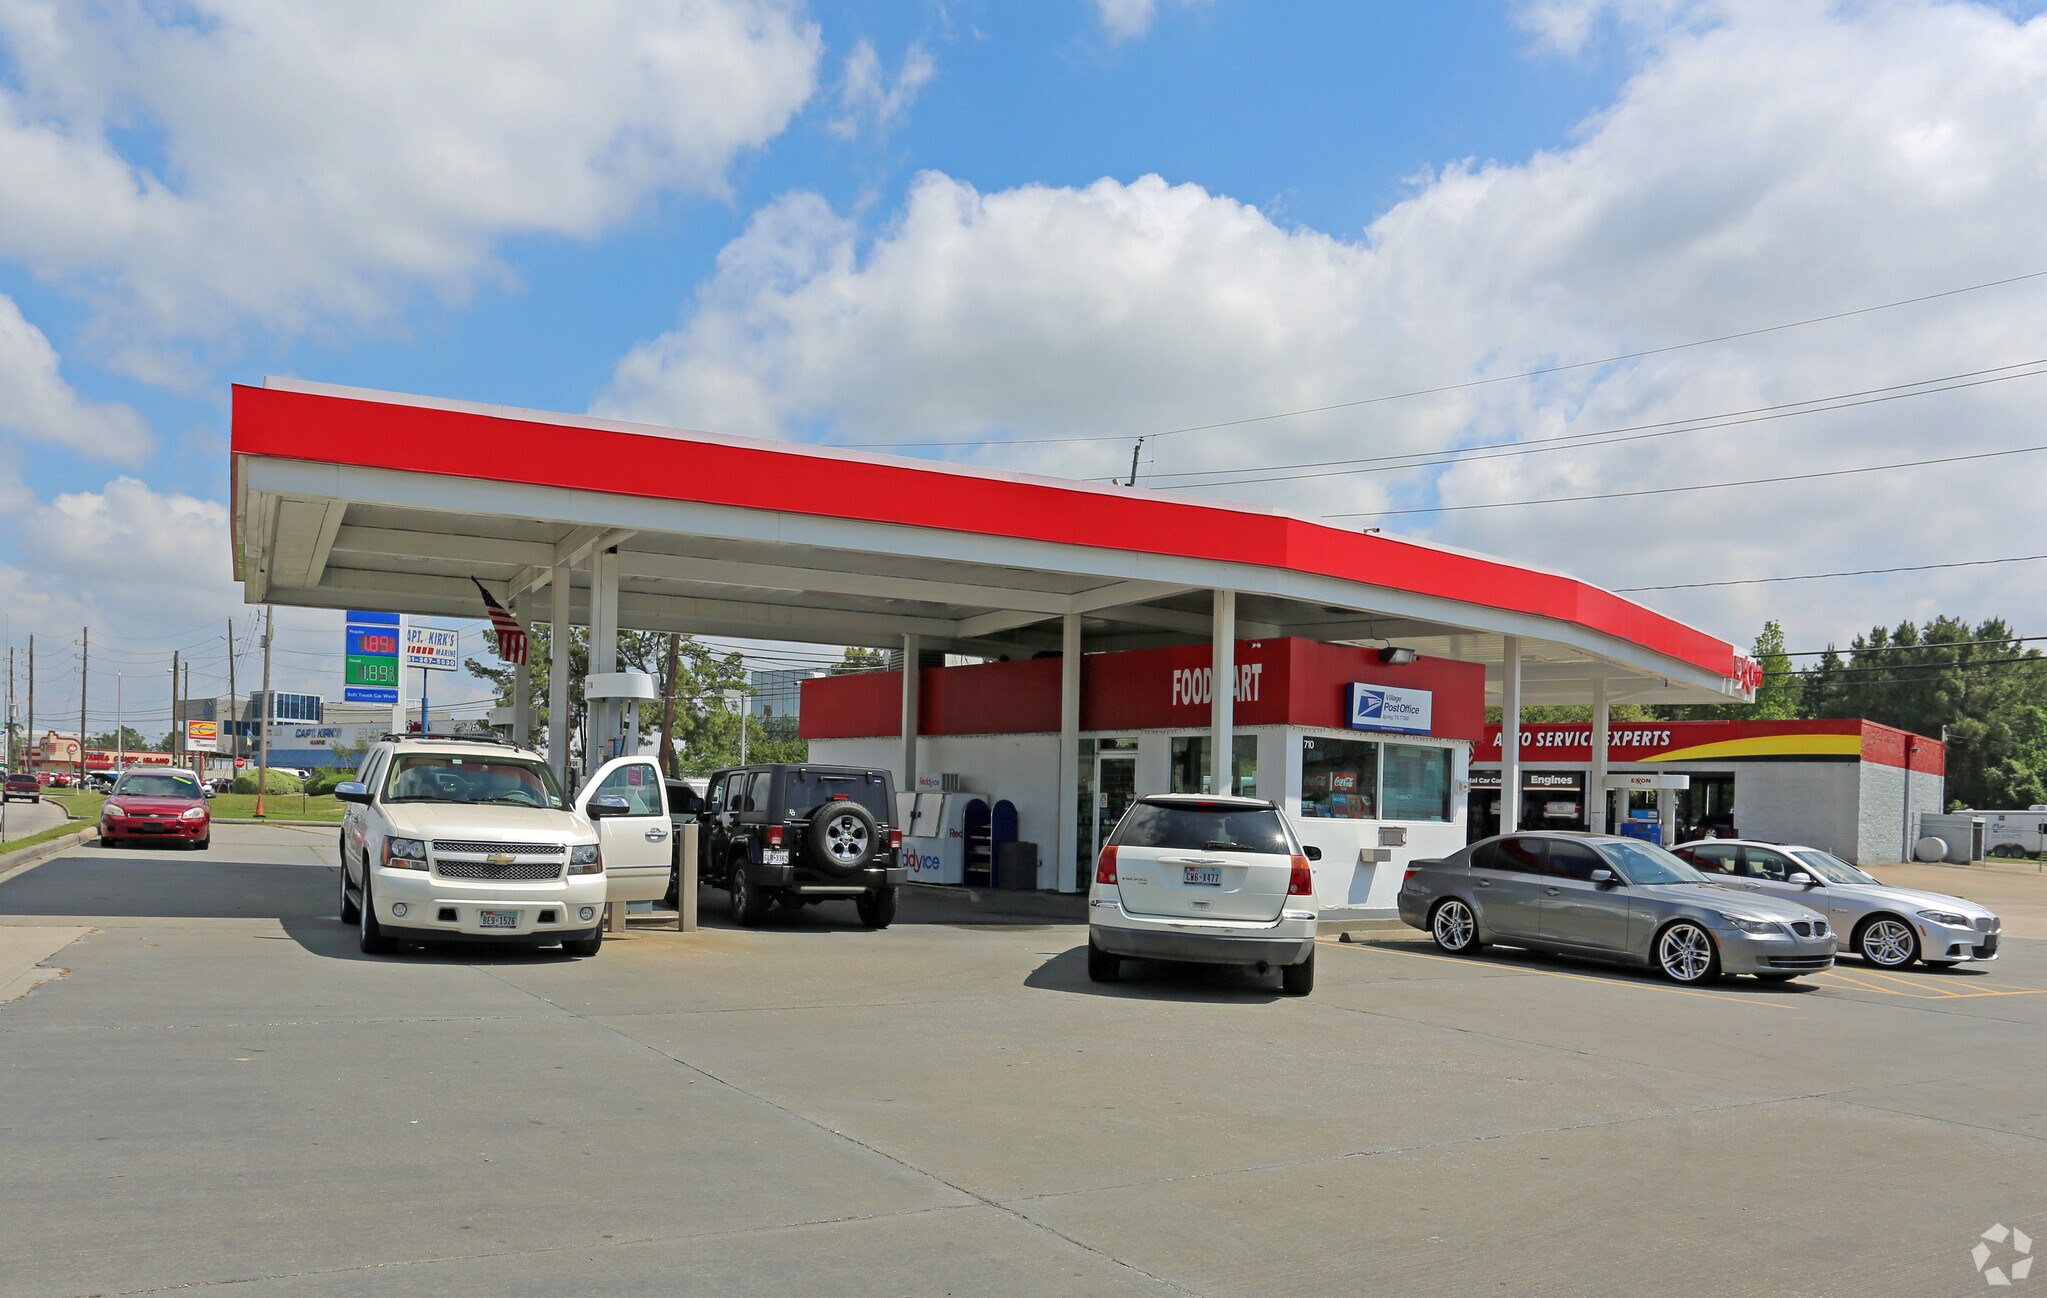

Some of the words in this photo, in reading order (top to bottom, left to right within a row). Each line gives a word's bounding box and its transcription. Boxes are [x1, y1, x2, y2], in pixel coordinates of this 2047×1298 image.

[407, 629, 423, 643] APT.
[428, 631, 455, 647] KIRK'S
[1172, 667, 1213, 706] FOOD
[1233, 663, 1263, 702] ART
[1385, 693, 1402, 703] Village
[1383, 702, 1399, 713] Post
[1400, 703, 1420, 715] Office
[1492, 731, 1532, 747] AO
[1536, 731, 1594, 747] SERVIC
[1303, 740, 1315, 750] 710
[143, 756, 170, 764] ISLAND
[1531, 775, 1573, 786] Engines
[1631, 777, 1651, 785] EXXON
